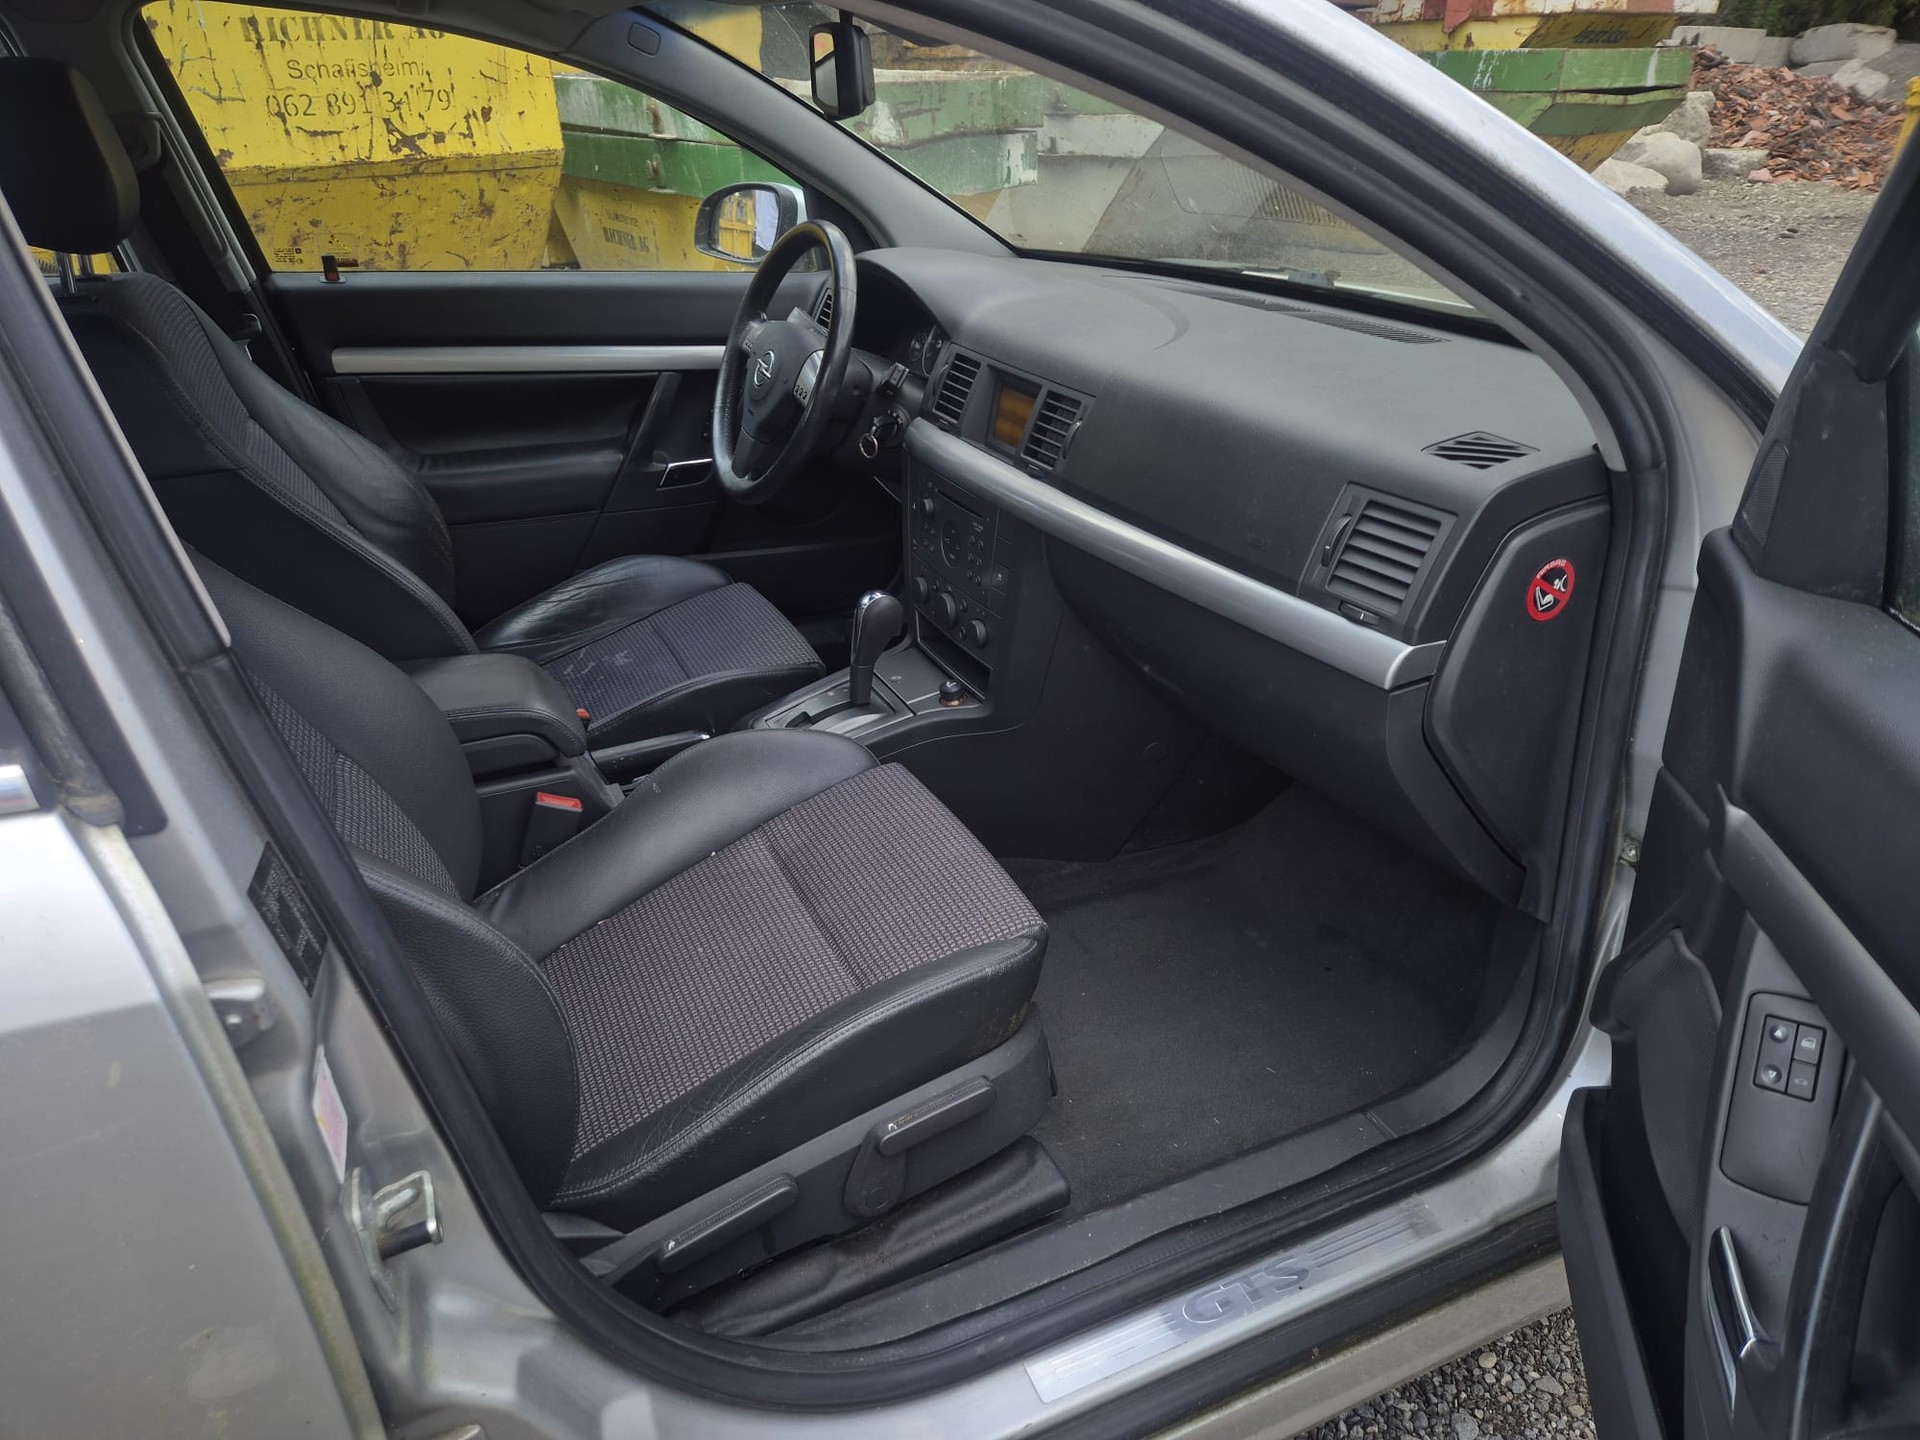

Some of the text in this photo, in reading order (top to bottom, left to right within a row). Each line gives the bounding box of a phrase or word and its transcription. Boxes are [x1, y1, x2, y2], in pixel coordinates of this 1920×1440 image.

[266, 92, 316, 119] 062
[325, 90, 373, 115] 891
[421, 88, 452, 113] 79
[1181, 1255, 1311, 1325] GTS
